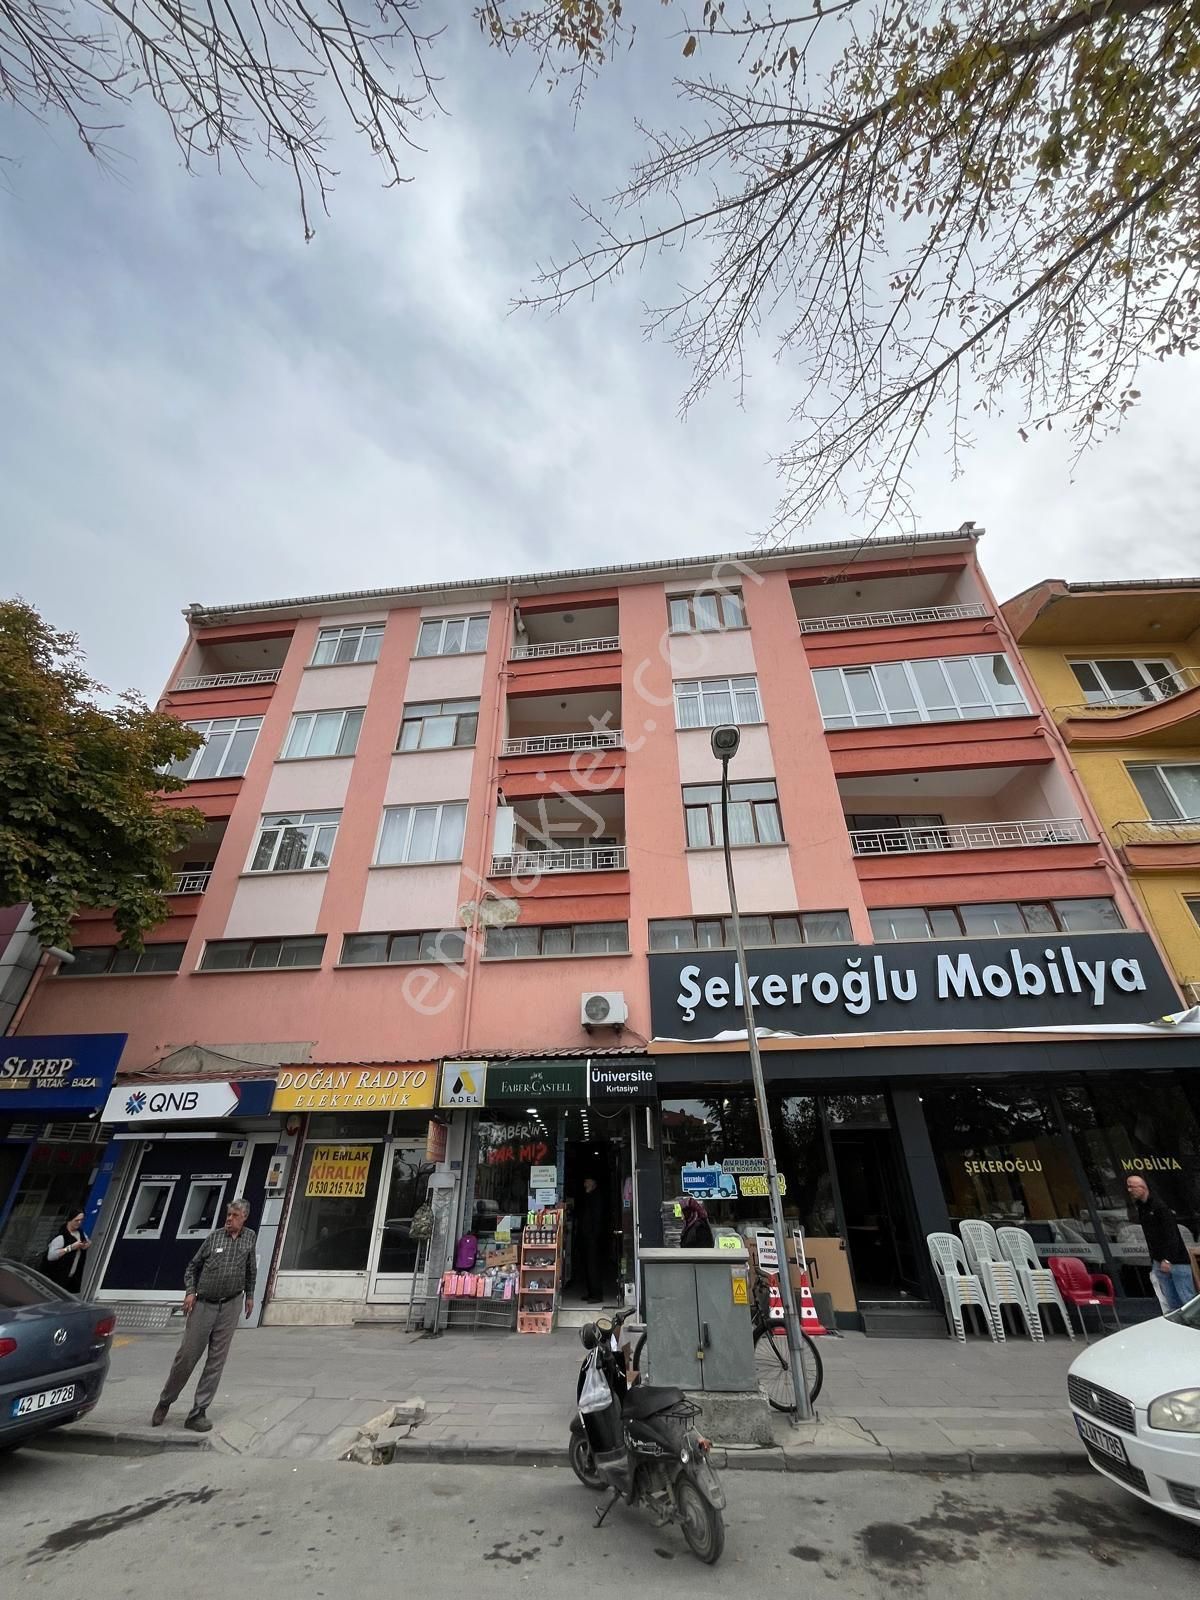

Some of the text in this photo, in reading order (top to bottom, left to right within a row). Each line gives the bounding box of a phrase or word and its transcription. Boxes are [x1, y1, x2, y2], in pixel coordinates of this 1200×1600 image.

[677, 947, 1147, 1022] Şekeroğlu Mobilya
[0, 1057, 74, 1079] SLEEP
[592, 1068, 653, 1083] Üniversite
[72, 1078, 96, 1088] BAZA
[277, 1069, 427, 1089] DOĞAN RADYO
[149, 1091, 199, 1112] QNB
[295, 1093, 411, 1107] ELEKTRONİK
[315, 1149, 370, 1160] İYİ EMLAK
[311, 1163, 367, 1179] KİRALIK
[964, 1155, 1182, 1176] ŞEKEROĞLU MOBİLYA
[309, 1182, 365, 1194] 0 530 215 74 32
[19, 1397, 33, 1413] 42
[50, 1386, 74, 1405] 2728
